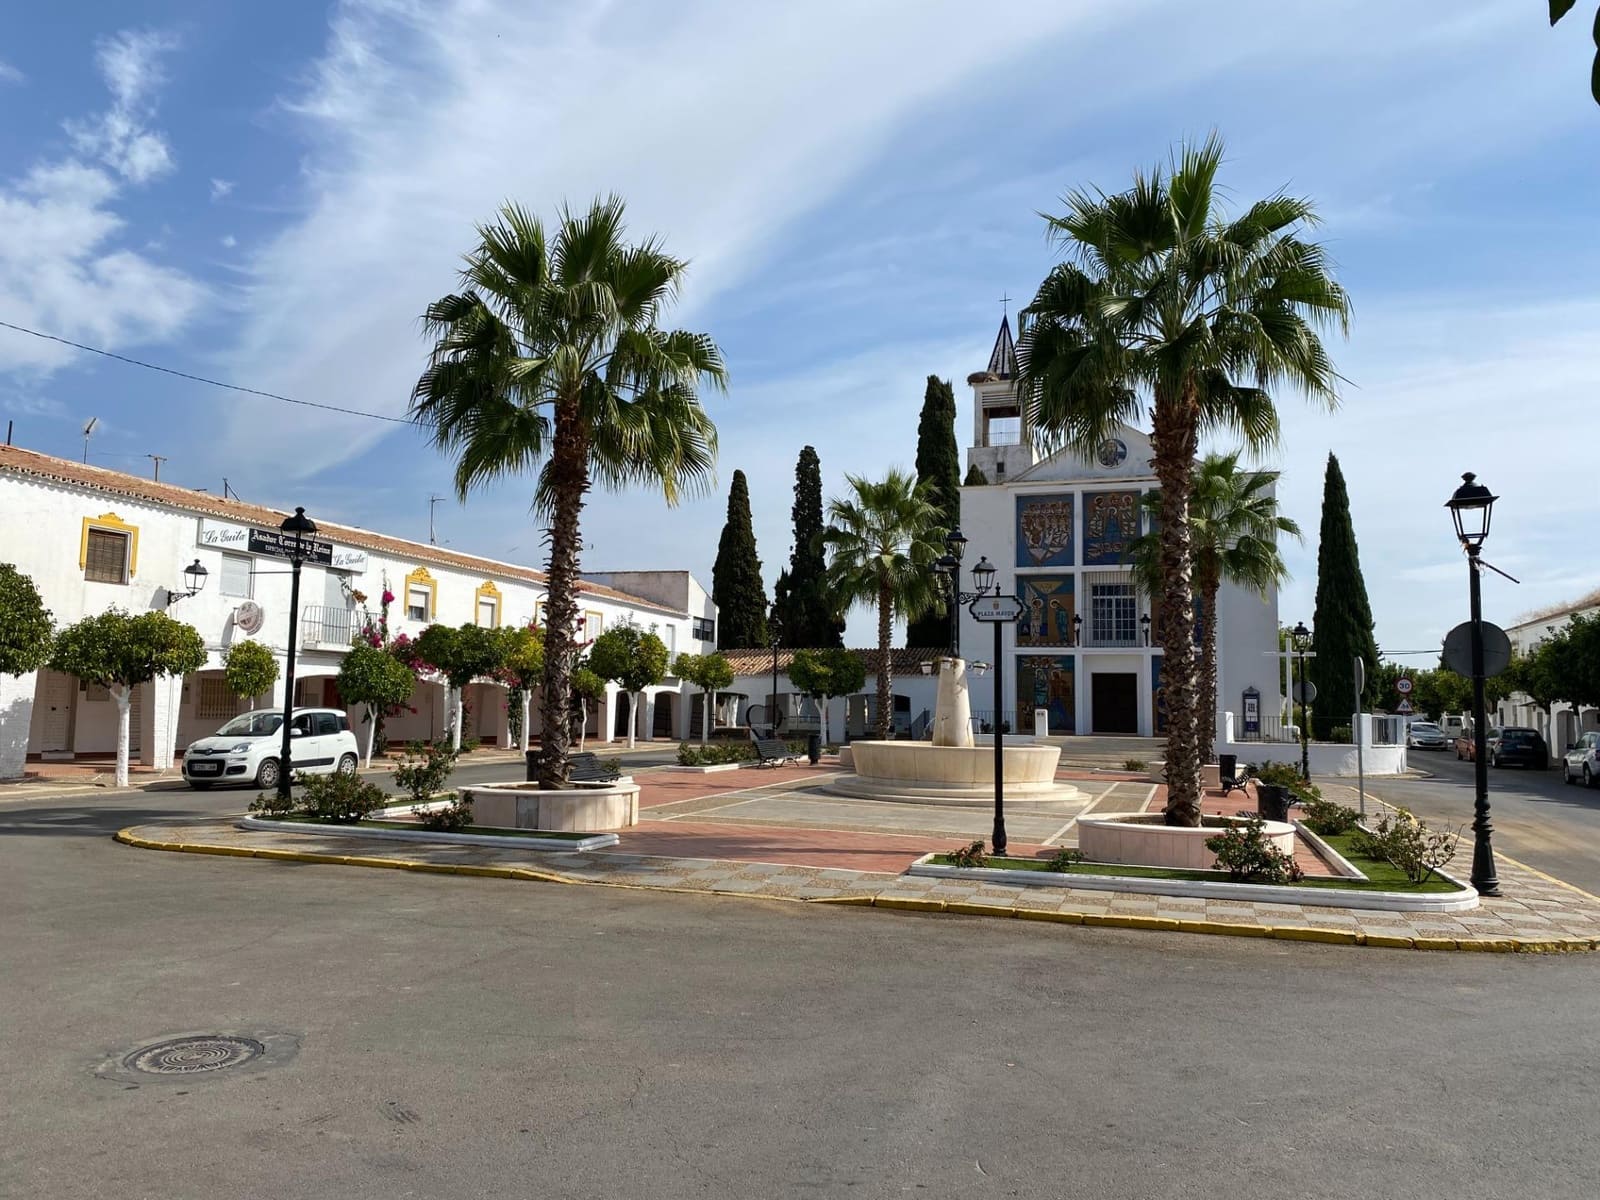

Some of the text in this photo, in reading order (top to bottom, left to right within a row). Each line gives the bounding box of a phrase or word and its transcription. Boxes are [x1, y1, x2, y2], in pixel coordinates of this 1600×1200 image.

[220, 529, 246, 543] Guita
[251, 529, 278, 544] Asador
[305, 541, 313, 551] la
[313, 542, 332, 554] Reina
[345, 552, 365, 565] Guita
